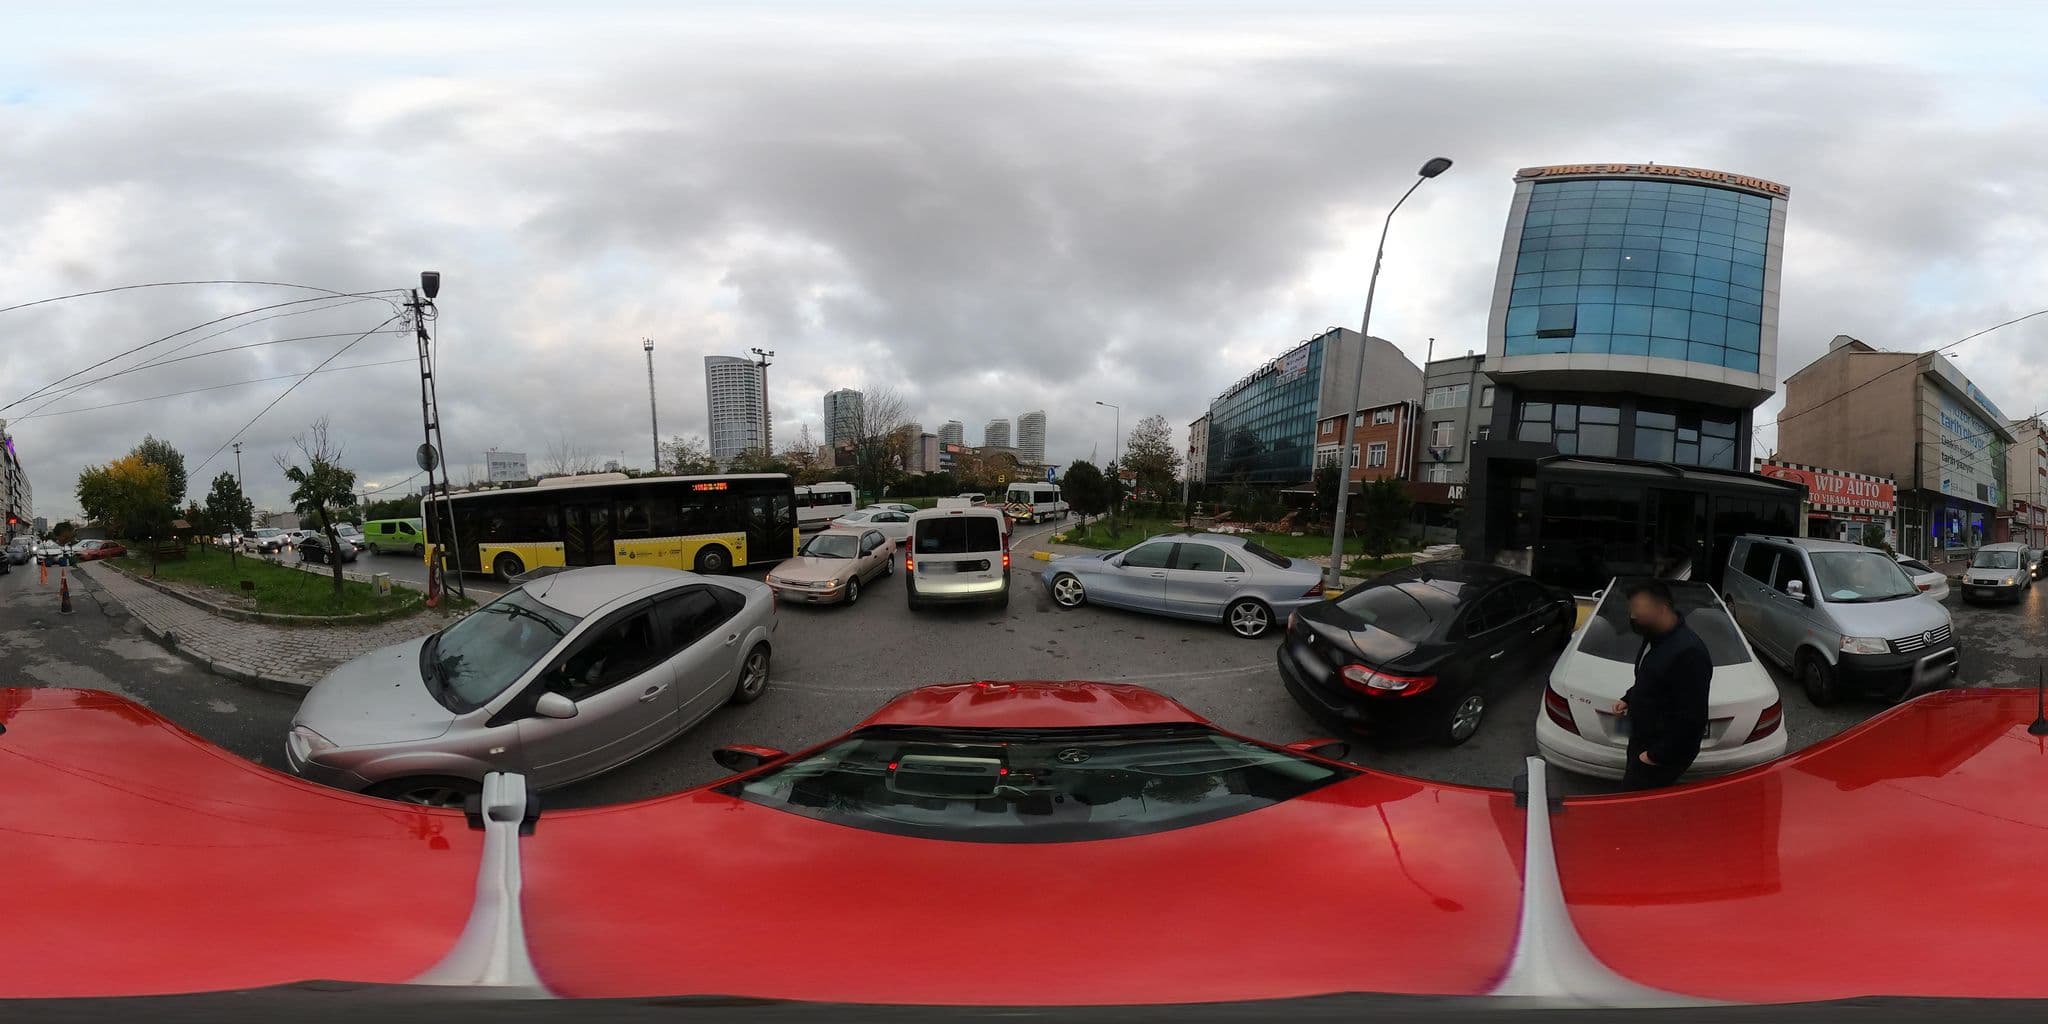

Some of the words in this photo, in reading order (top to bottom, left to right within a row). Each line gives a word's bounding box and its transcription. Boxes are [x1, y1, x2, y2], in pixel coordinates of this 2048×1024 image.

[1447, 485, 1466, 499] AR
[1815, 475, 1843, 493] WIP
[1846, 480, 1880, 498] AUTO
[1808, 492, 1820, 501] TO
[1822, 494, 1851, 506] YIKAMA
[1861, 499, 1892, 510] OTOPARK
